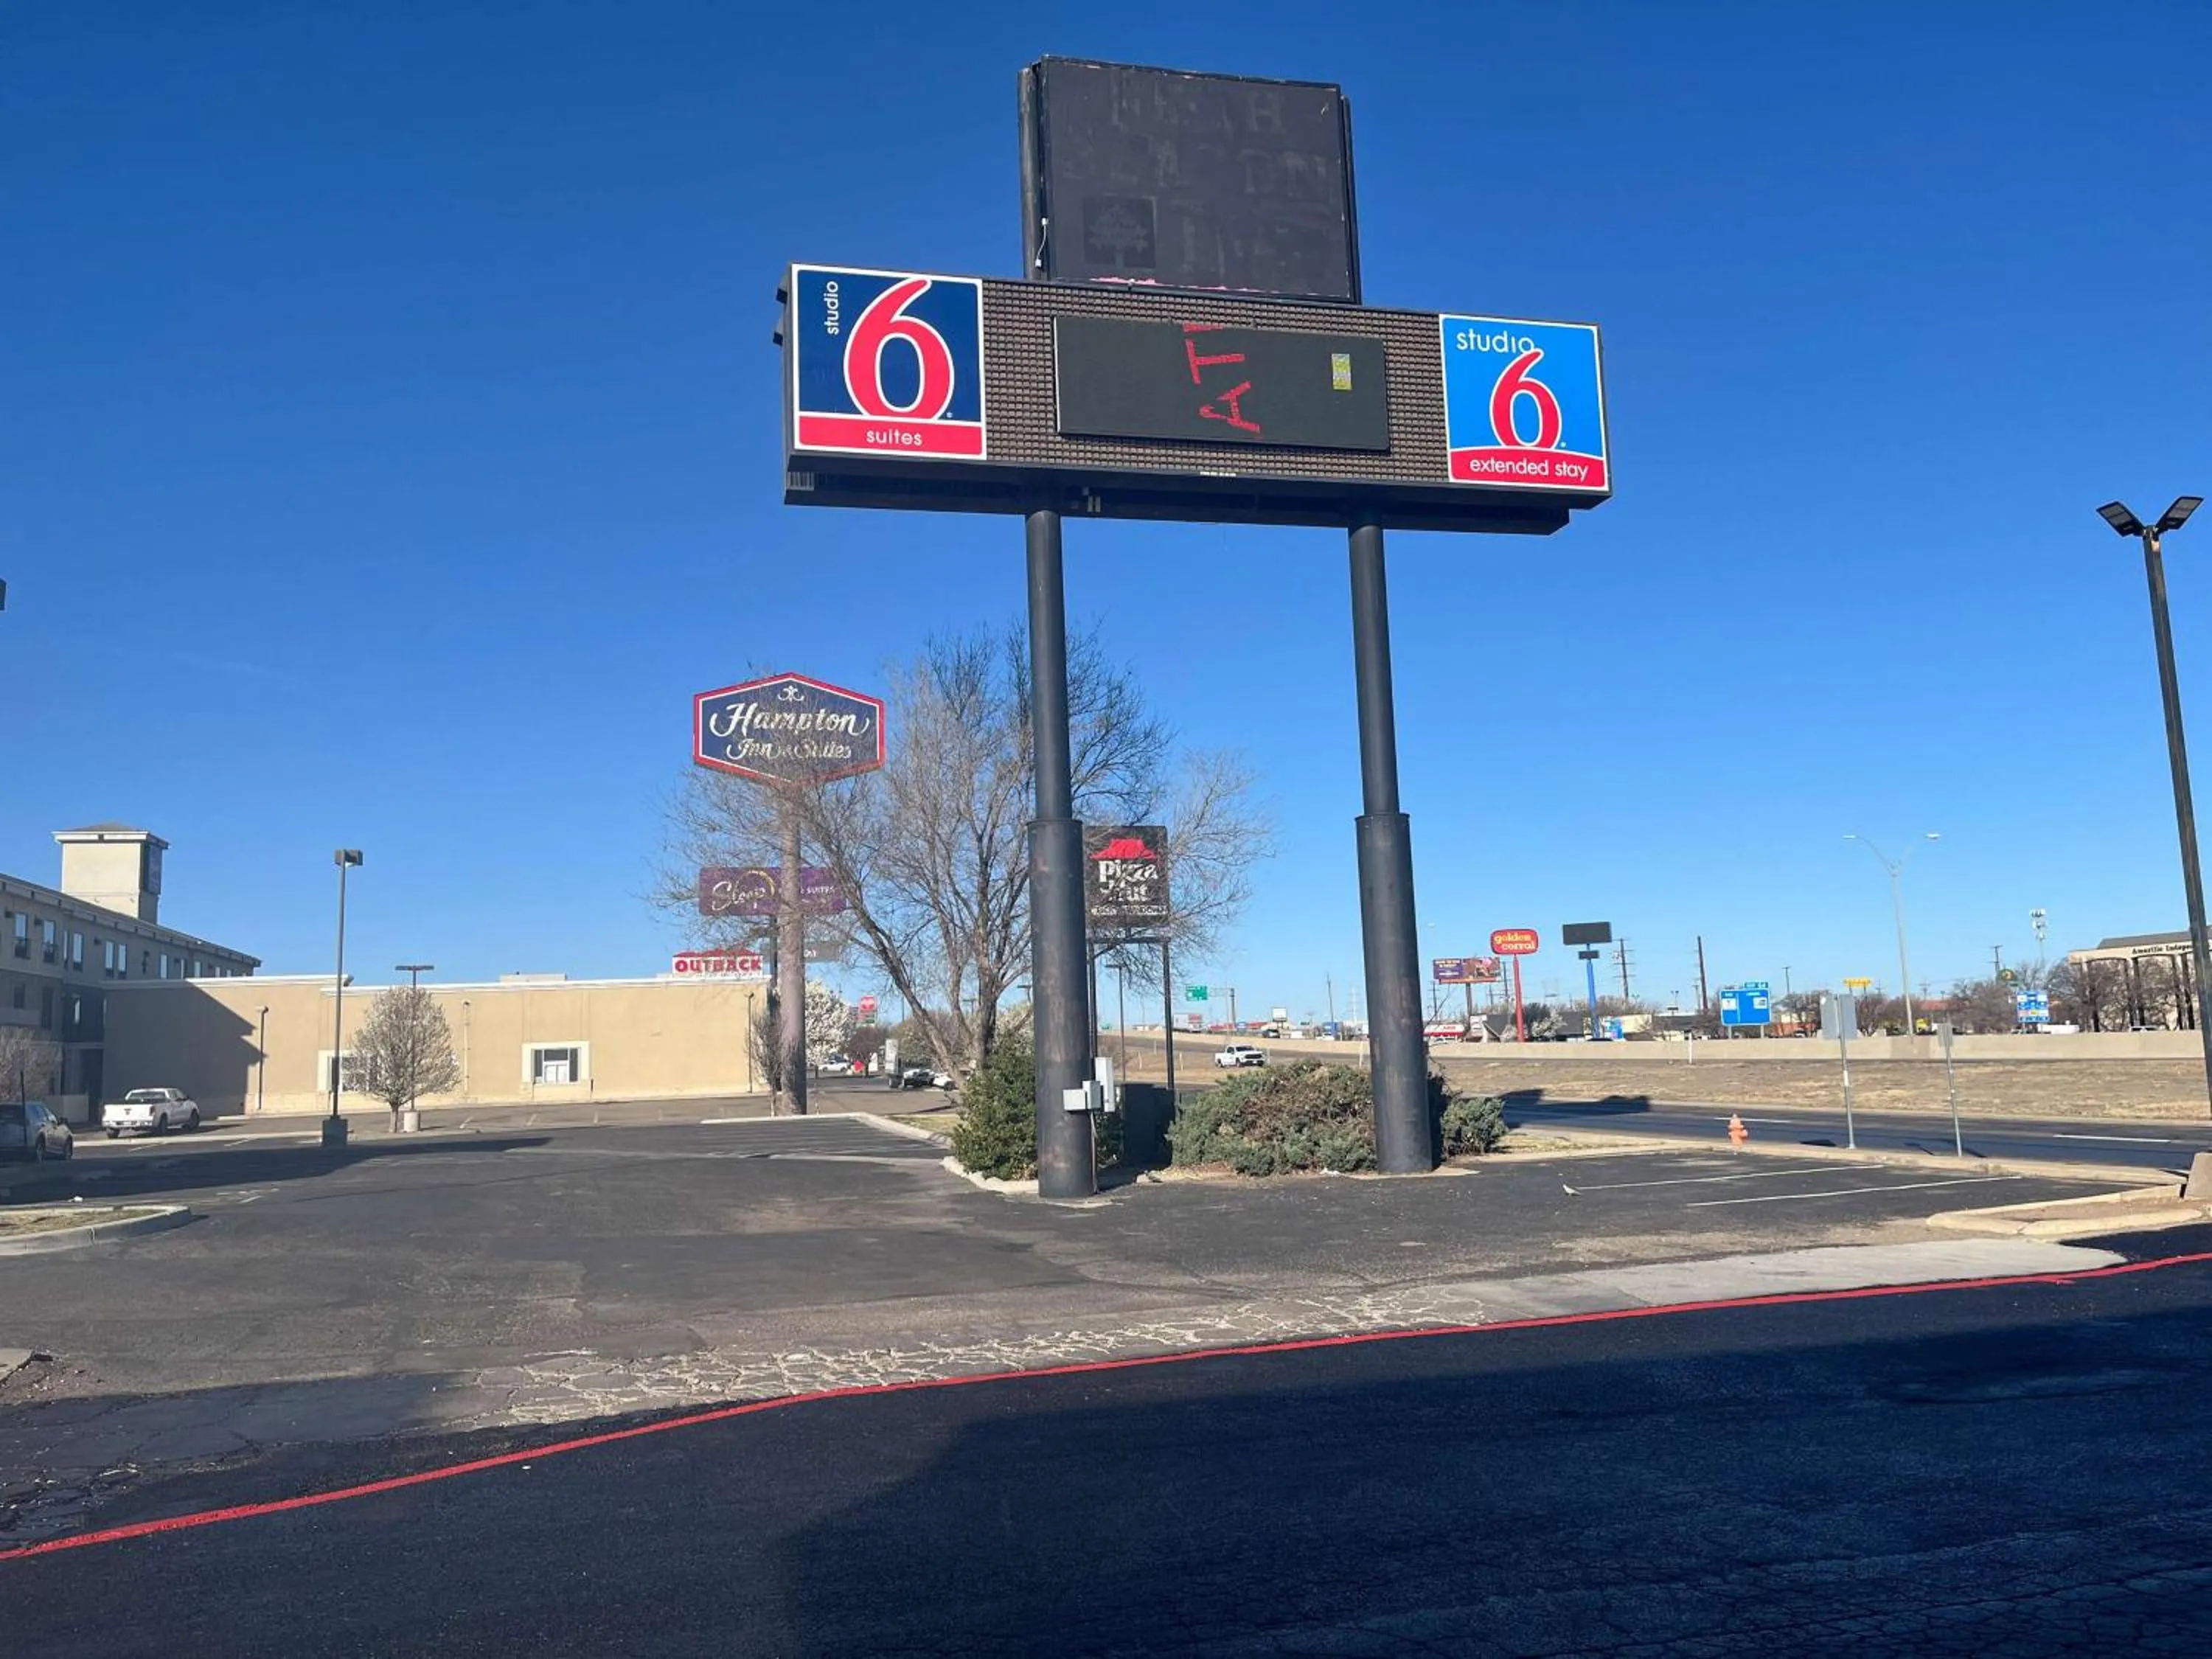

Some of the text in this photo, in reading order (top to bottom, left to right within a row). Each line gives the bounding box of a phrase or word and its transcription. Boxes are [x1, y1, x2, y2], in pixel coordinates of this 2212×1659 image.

[824, 281, 839, 335] studio
[844, 276, 955, 421] 6
[1456, 328, 1534, 354] studio
[1489, 348, 1562, 451] 6
[866, 428, 922, 447] suites
[1470, 457, 1589, 483] extended stay
[709, 702, 870, 737] Hampton
[726, 738, 781, 760] Inn
[1098, 859, 1158, 883] Pizza
[1494, 931, 1532, 944] golden
[1500, 940, 1535, 950] corral
[675, 959, 762, 973] OUTBACK
